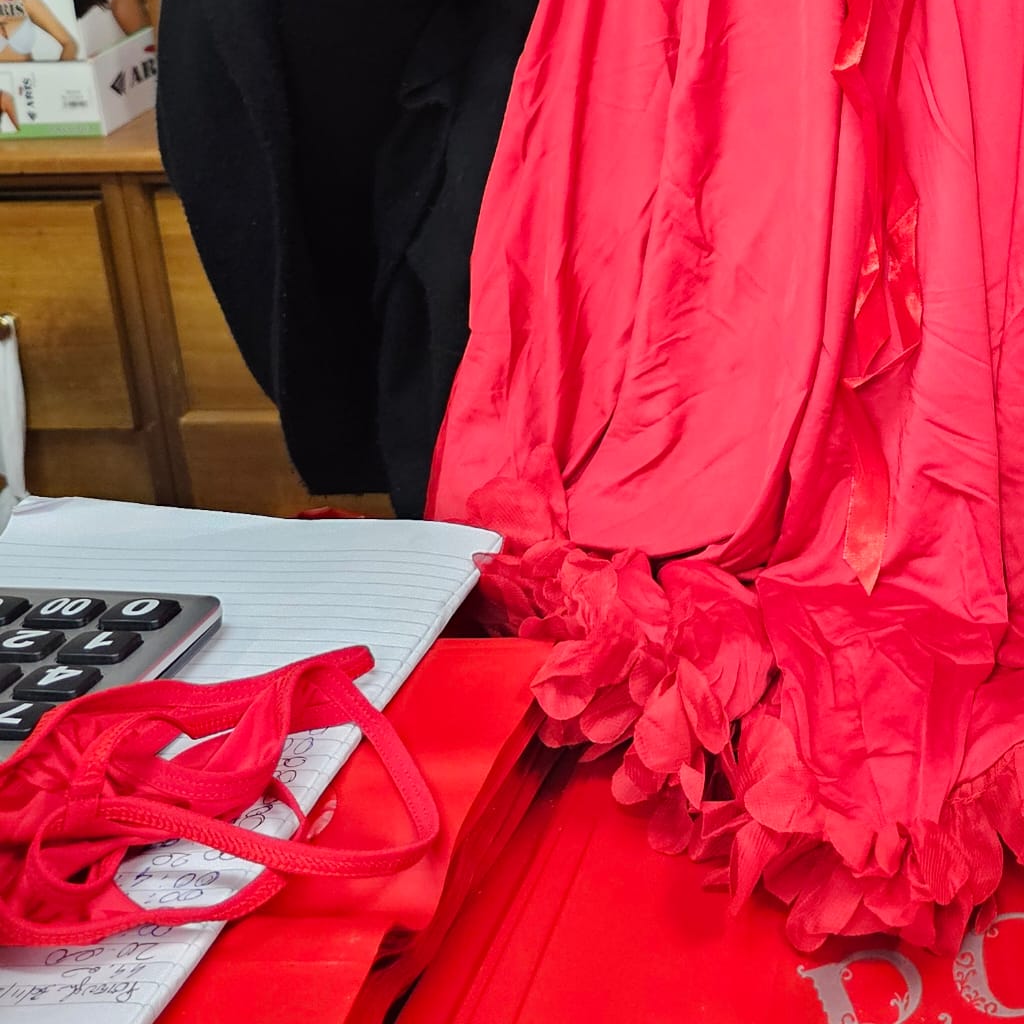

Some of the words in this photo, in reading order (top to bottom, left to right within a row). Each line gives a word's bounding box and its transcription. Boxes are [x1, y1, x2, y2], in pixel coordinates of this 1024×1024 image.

[121, 598, 160, 616] 0
[2, 630, 51, 648] 2
[84, 631, 114, 650] 1
[37, 665, 83, 686] 4
[0, 702, 34, 724] 7
